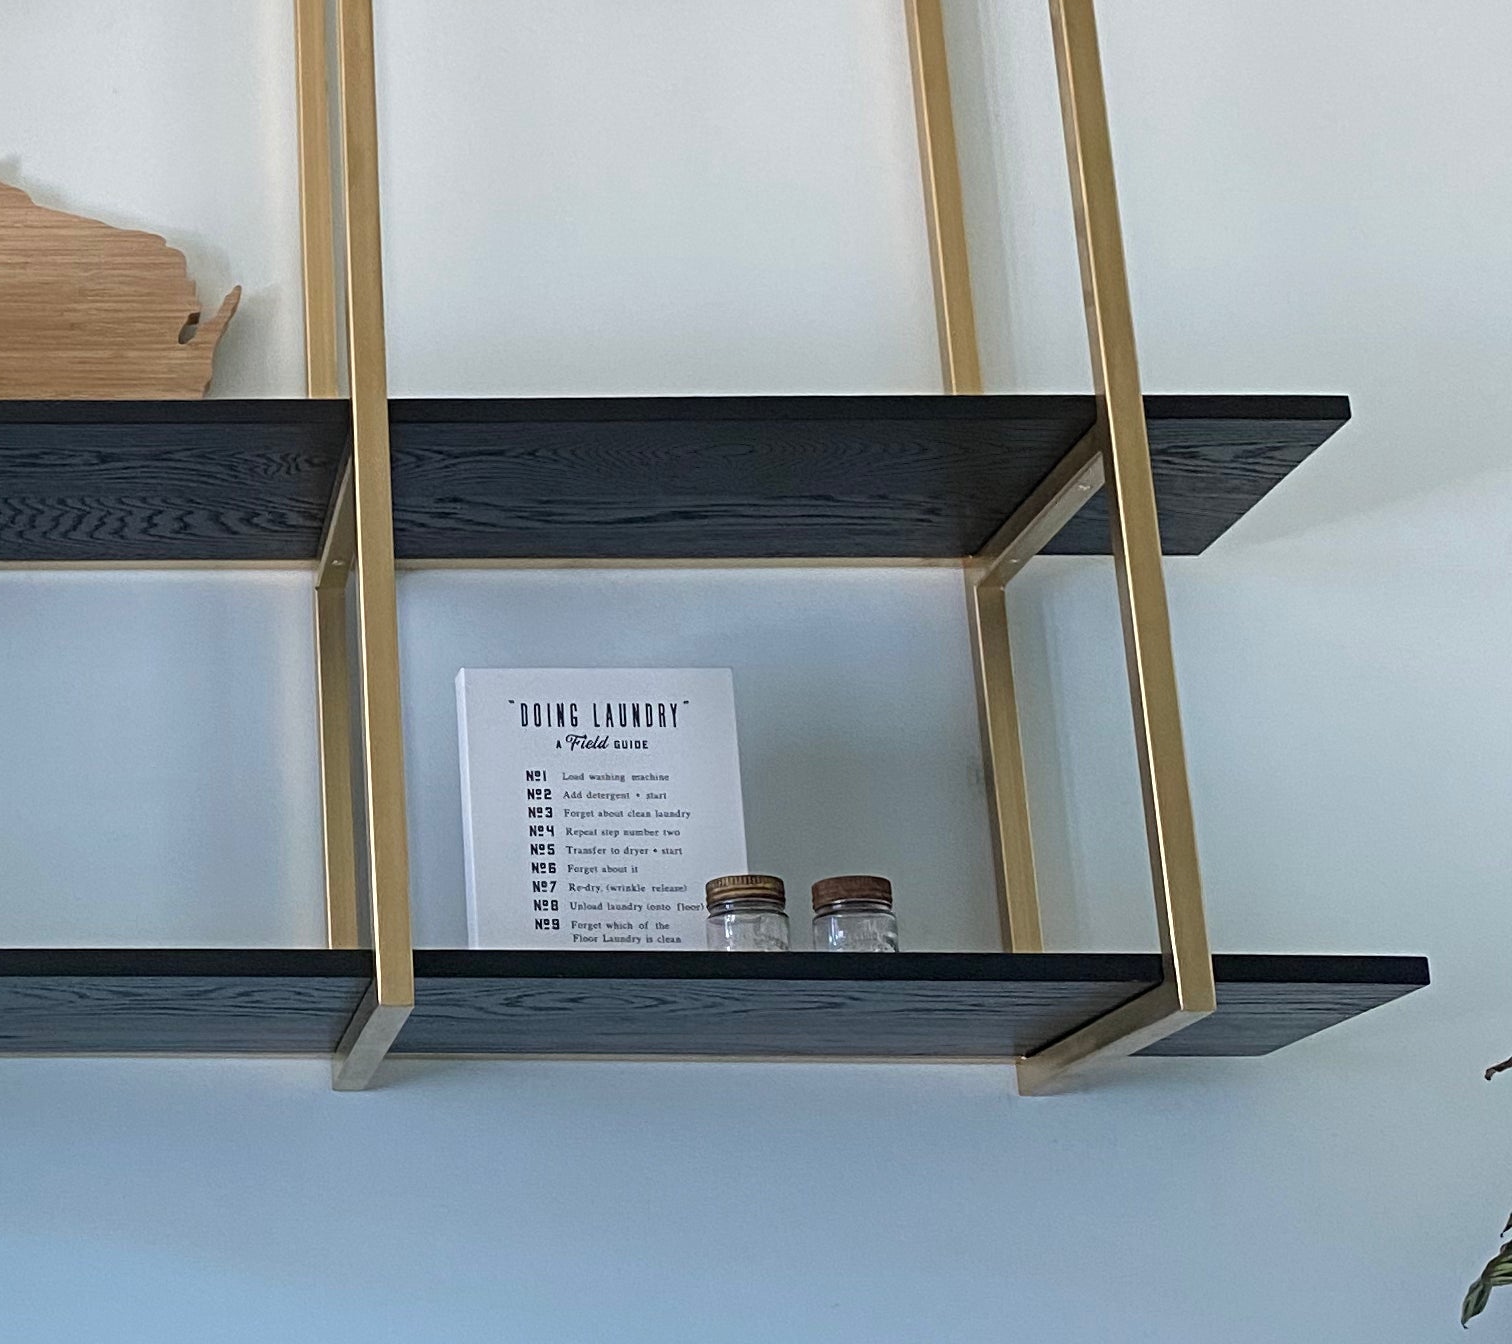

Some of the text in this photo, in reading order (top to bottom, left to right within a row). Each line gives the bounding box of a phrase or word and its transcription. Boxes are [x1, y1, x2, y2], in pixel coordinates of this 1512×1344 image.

[555, 733, 649, 751] A Field GUIDE
[562, 772, 585, 781] Load
[589, 772, 625, 783] washing
[631, 772, 670, 781] machine
[563, 791, 583, 799] Add
[586, 791, 630, 802] detergent
[646, 792, 667, 800] start
[564, 809, 594, 820] Forget
[598, 809, 624, 818] about
[627, 809, 651, 818] clean
[655, 809, 691, 820] laundry
[565, 827, 598, 838] Repeat
[601, 828, 620, 838] step
[623, 828, 659, 837] number
[663, 828, 681, 836] two
[565, 845, 607, 855] Transfer
[610, 846, 620, 855] to
[623, 846, 649, 857] dryer
[661, 847, 683, 855] start
[567, 864, 598, 875] Forget
[601, 865, 628, 873] about
[631, 865, 639, 873] it
[606, 883, 646, 893] (wrinkle
[651, 884, 688, 893] release)
[569, 901, 603, 911] Unload
[607, 902, 643, 913] laundry
[646, 903, 671, 911] (onto
[676, 902, 705, 912] floor)
[571, 920, 602, 931] Forget
[606, 920, 633, 930] which
[638, 921, 649, 930] of
[655, 921, 670, 930] the
[573, 934, 682, 945] Floor Laundry is clean
